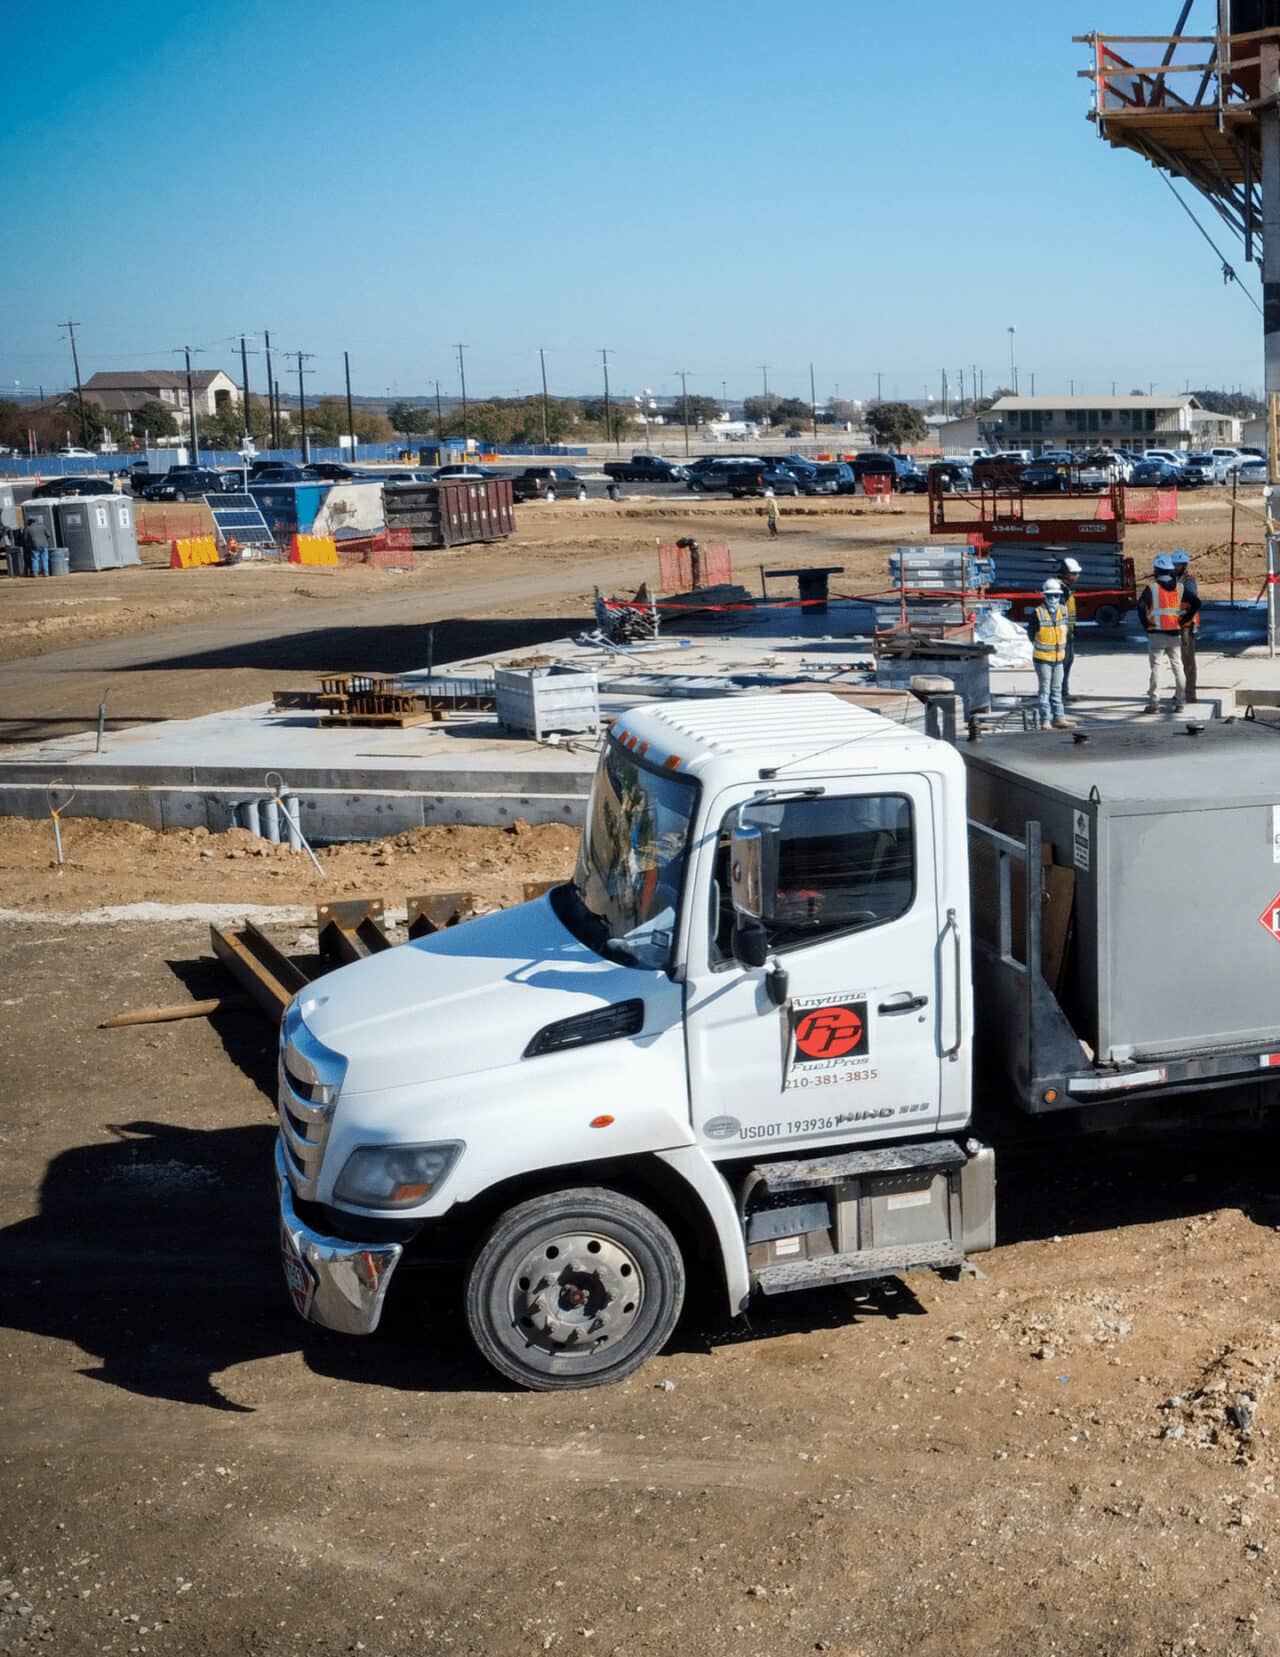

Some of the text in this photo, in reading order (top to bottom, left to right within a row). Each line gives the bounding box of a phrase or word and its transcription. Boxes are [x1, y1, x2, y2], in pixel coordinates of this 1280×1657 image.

[793, 992, 867, 1007] Anytime
[796, 1014, 863, 1053] FP
[784, 1069, 878, 1089] 210-381-3835
[740, 1122, 781, 1140] USDOT
